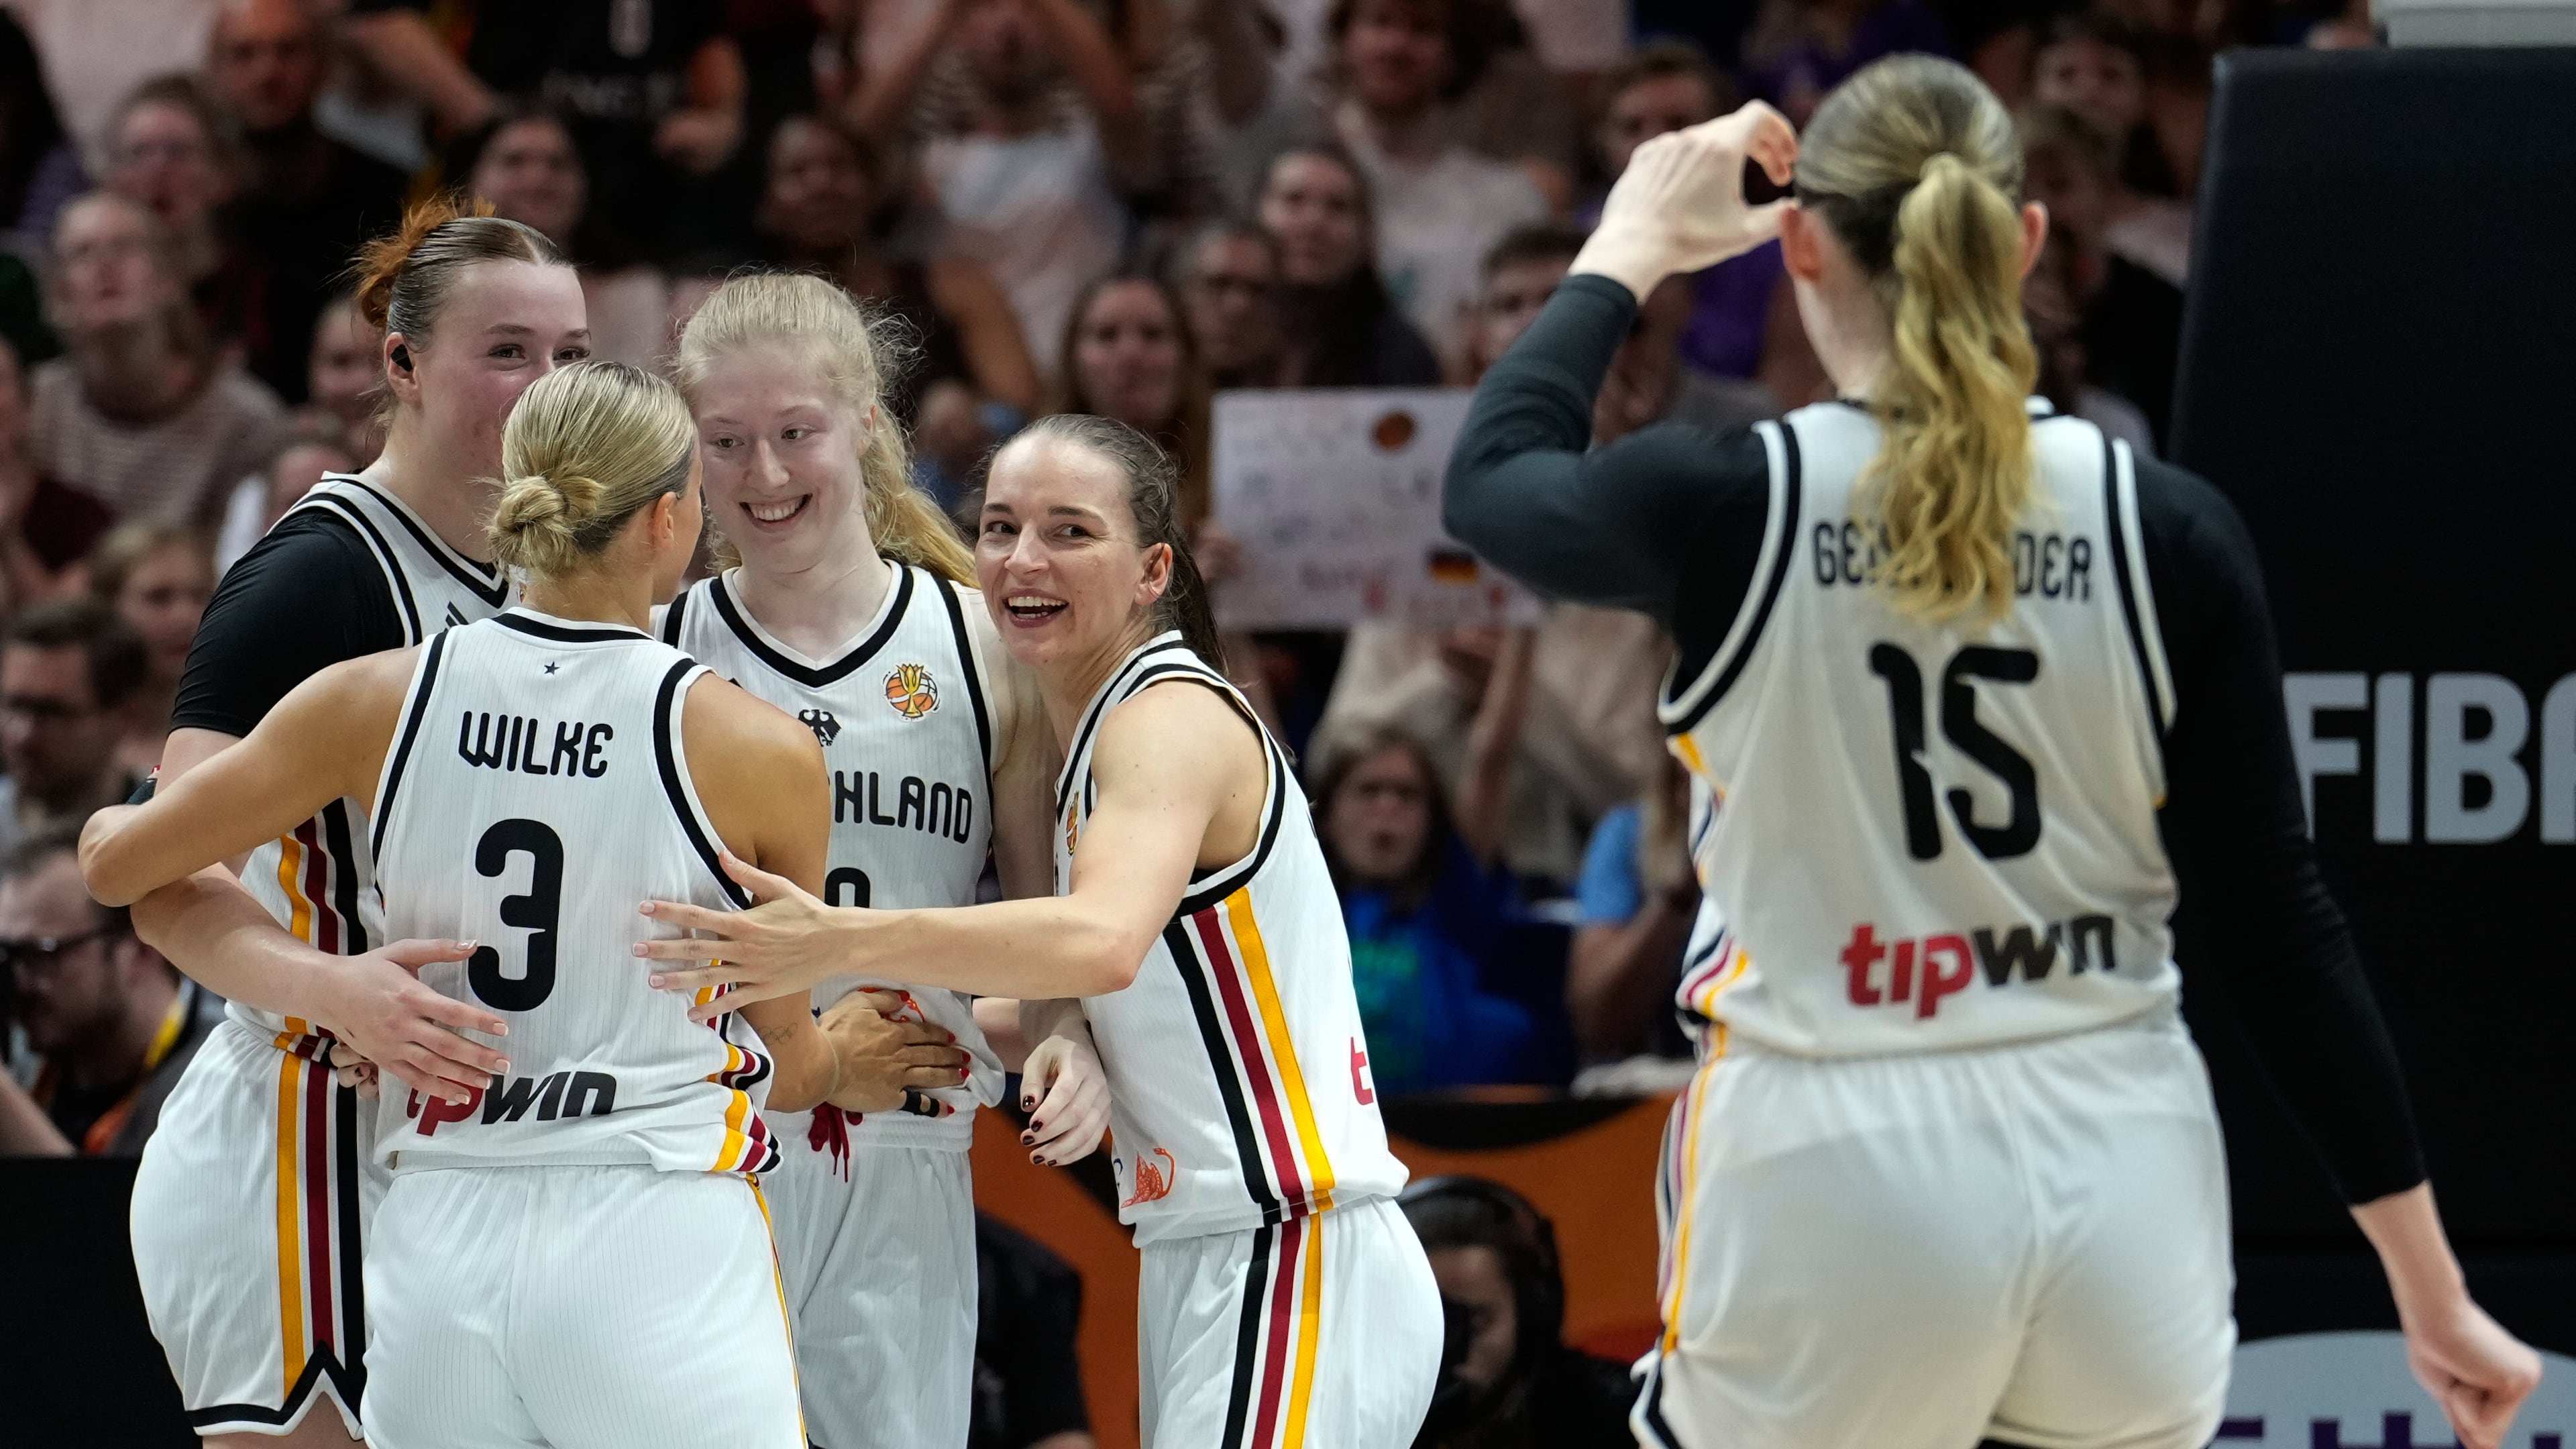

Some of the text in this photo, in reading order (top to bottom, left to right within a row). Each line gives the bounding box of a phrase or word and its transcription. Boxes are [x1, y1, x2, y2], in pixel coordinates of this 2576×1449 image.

[459, 711, 612, 778] WILKE
[828, 771, 972, 844] HLAND
[1867, 641, 2042, 862] 15
[468, 818, 564, 1012] 3
